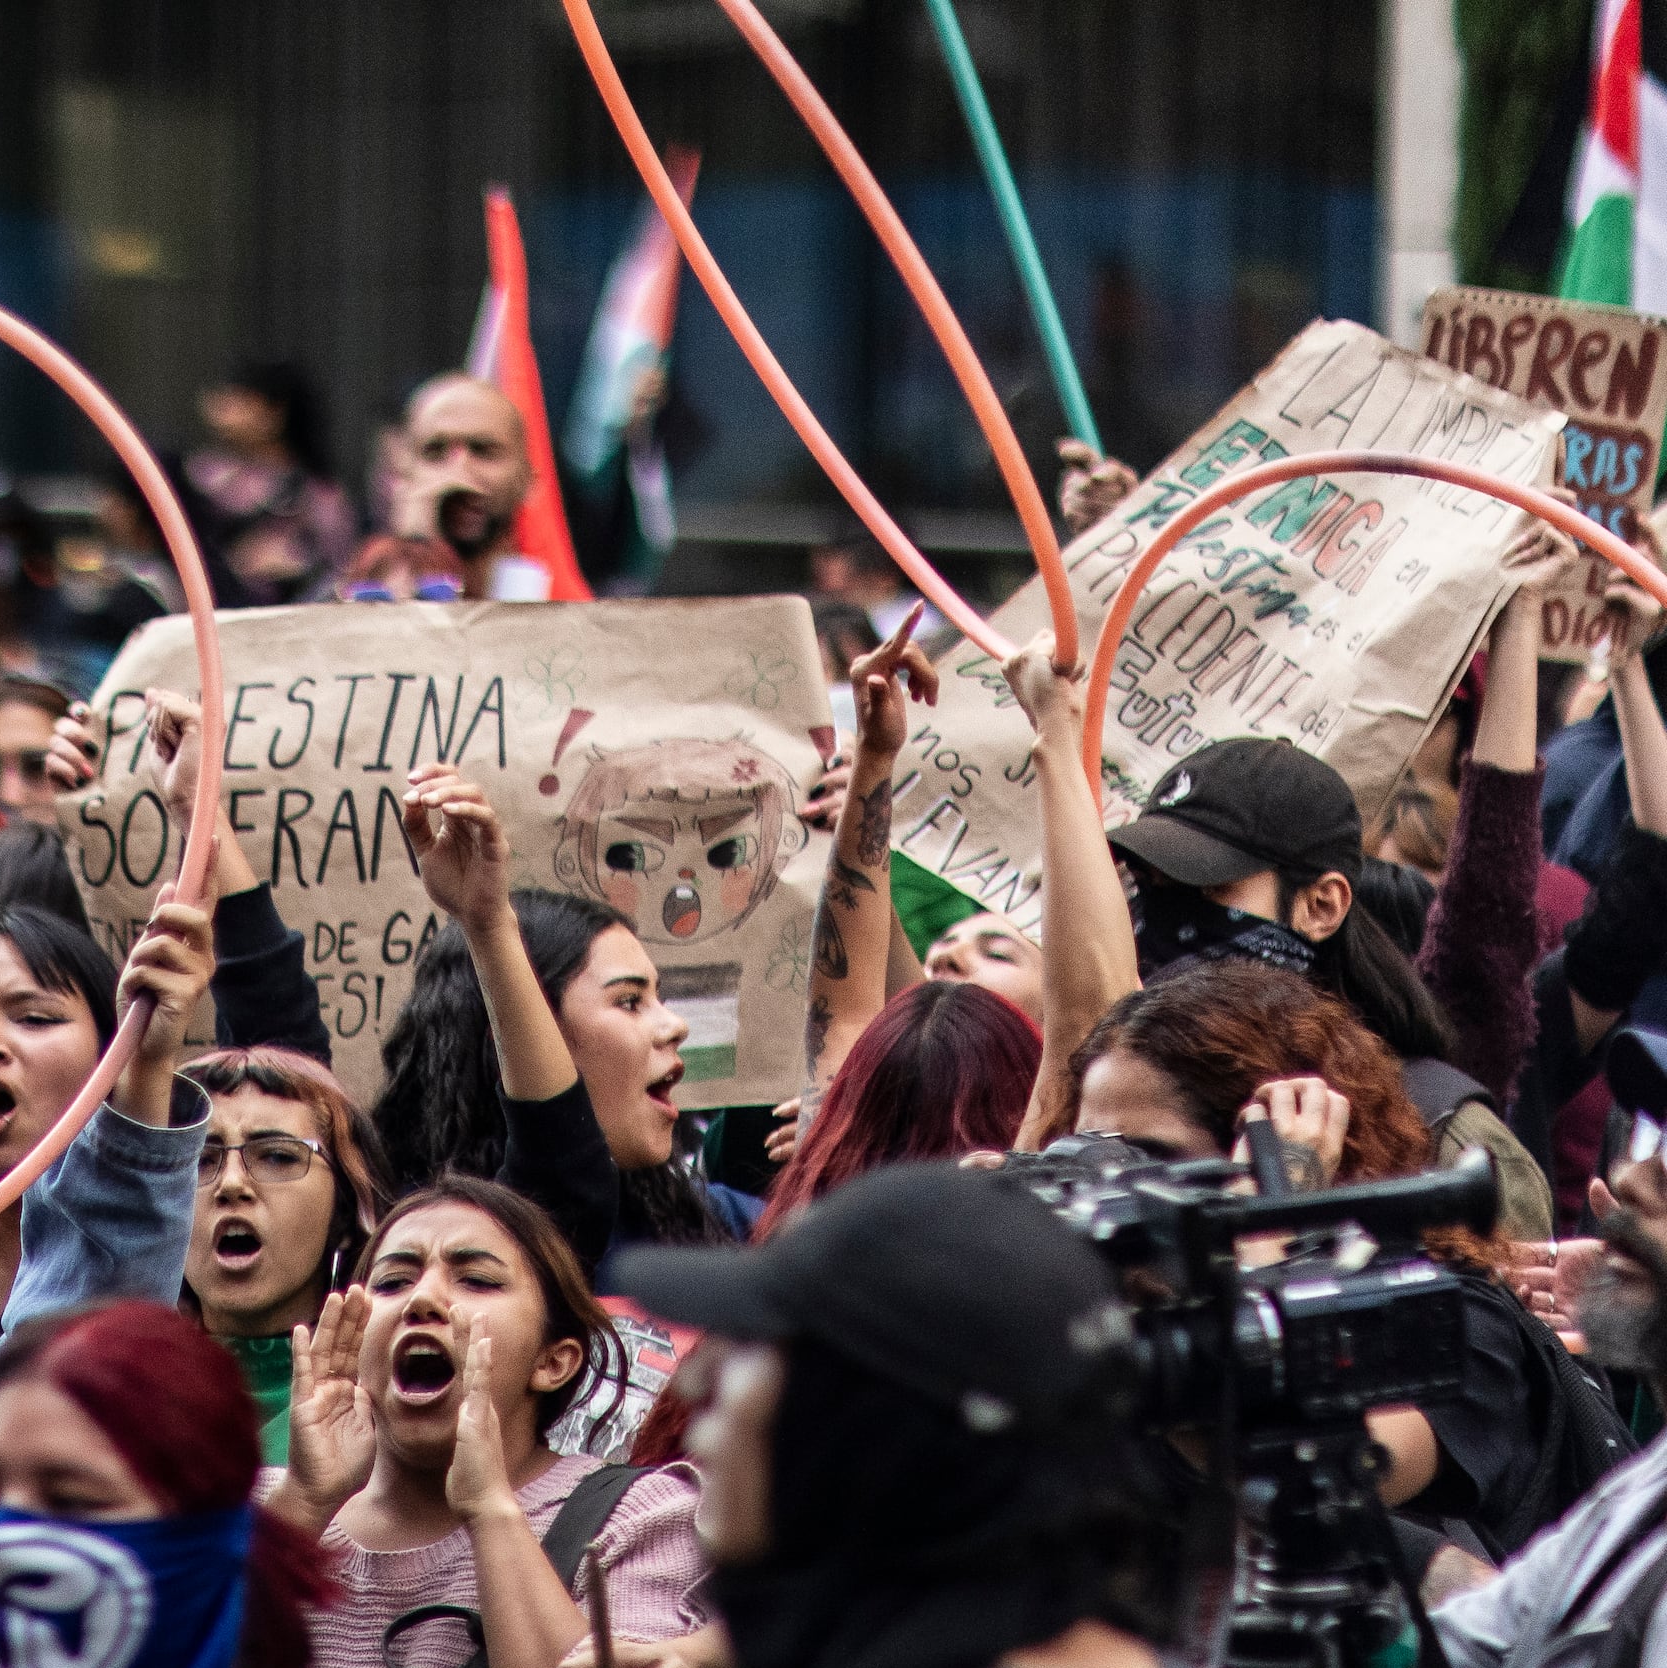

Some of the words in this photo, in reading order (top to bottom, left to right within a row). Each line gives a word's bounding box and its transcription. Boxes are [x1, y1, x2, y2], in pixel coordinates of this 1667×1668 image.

[100, 671, 507, 779] PESTINA
[1107, 636, 1217, 757] Futu
[911, 724, 982, 798] nos
[313, 921, 358, 963] DE
